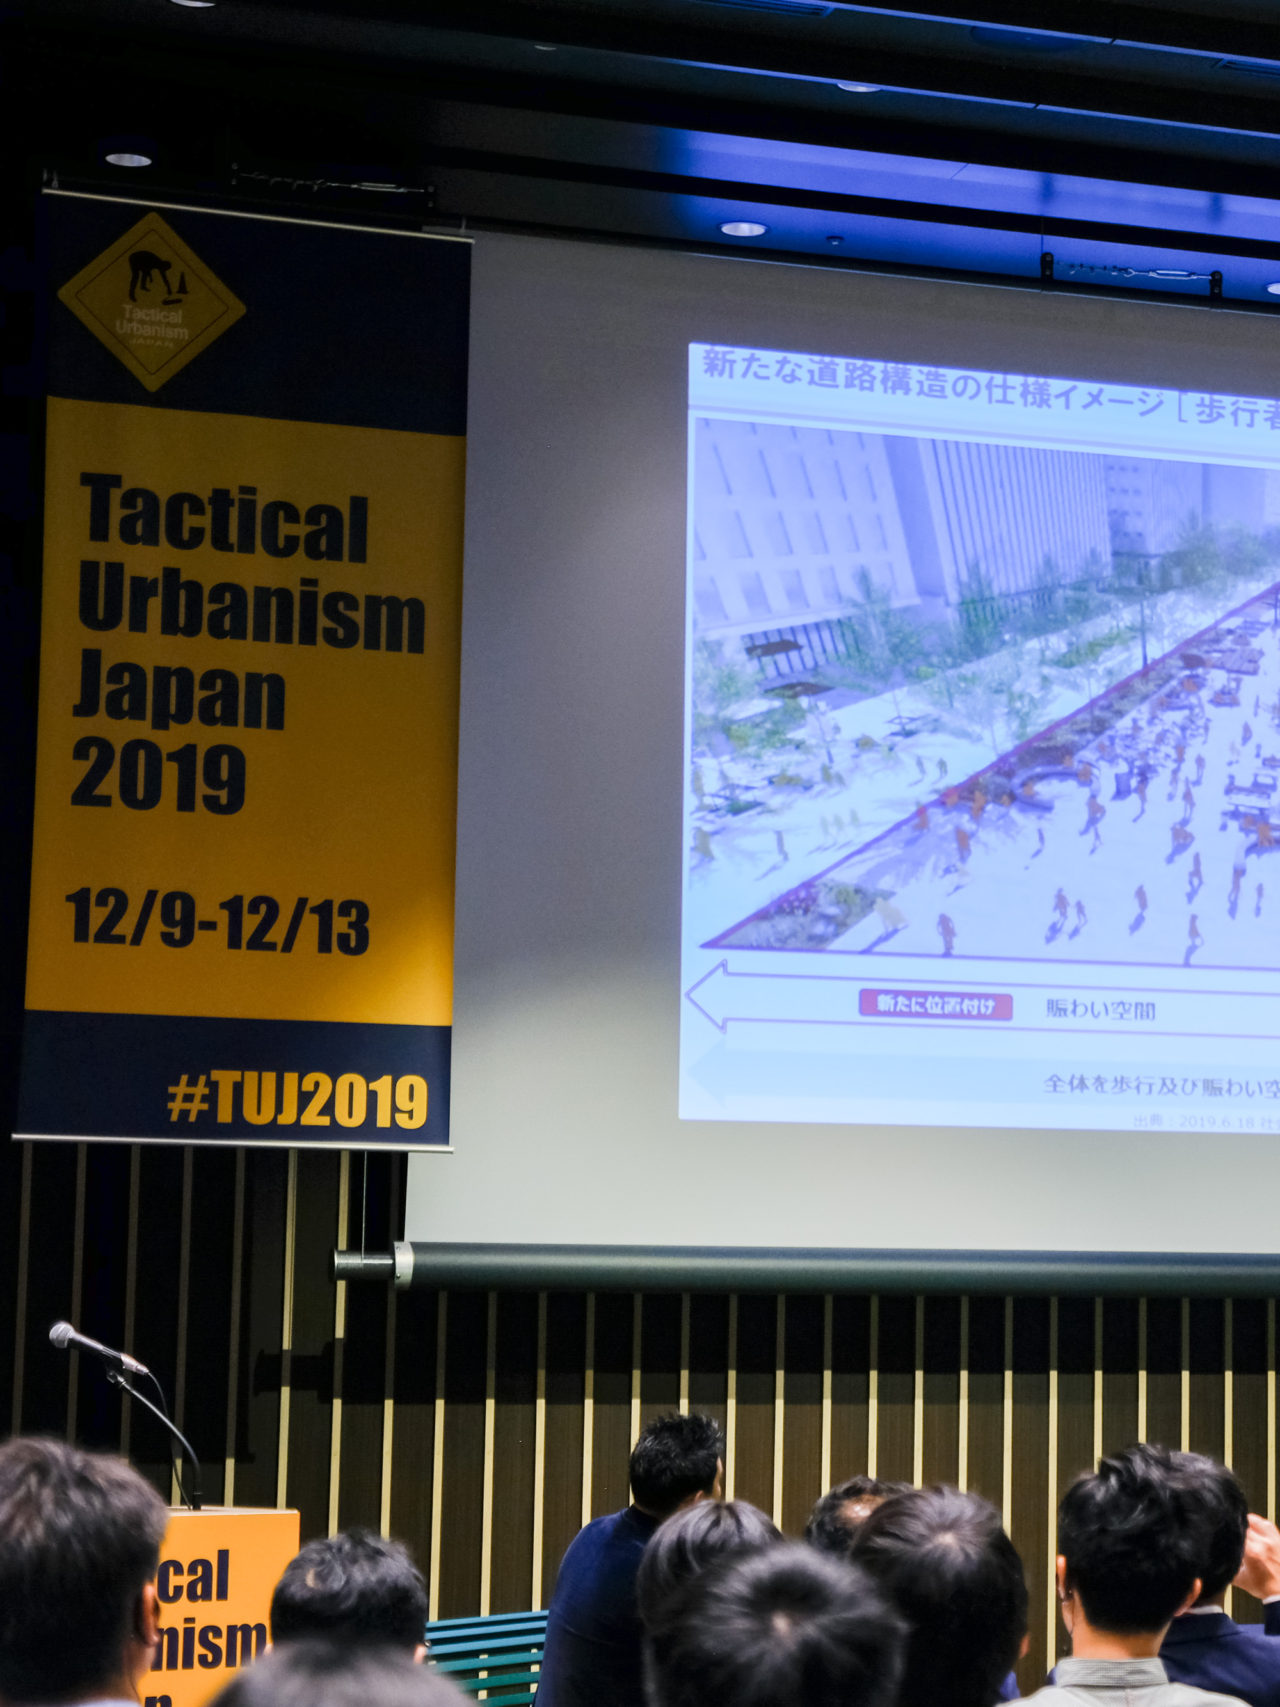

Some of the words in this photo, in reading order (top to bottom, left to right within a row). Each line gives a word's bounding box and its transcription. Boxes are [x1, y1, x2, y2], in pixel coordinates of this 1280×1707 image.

[115, 319, 190, 341] Urbanism
[122, 304, 183, 324] Tactical
[80, 472, 369, 564] Tactical
[78, 560, 425, 654] Urbanism
[72, 648, 286, 731] Japan
[70, 736, 247, 816] 2019
[65, 887, 370, 956] 12/9-12/13
[876, 993, 996, 1016] 新たに位置付け
[1046, 998, 1156, 1021] 賑わい空間
[167, 1069, 429, 1130] #TUJ2019
[157, 1549, 229, 1604] cal
